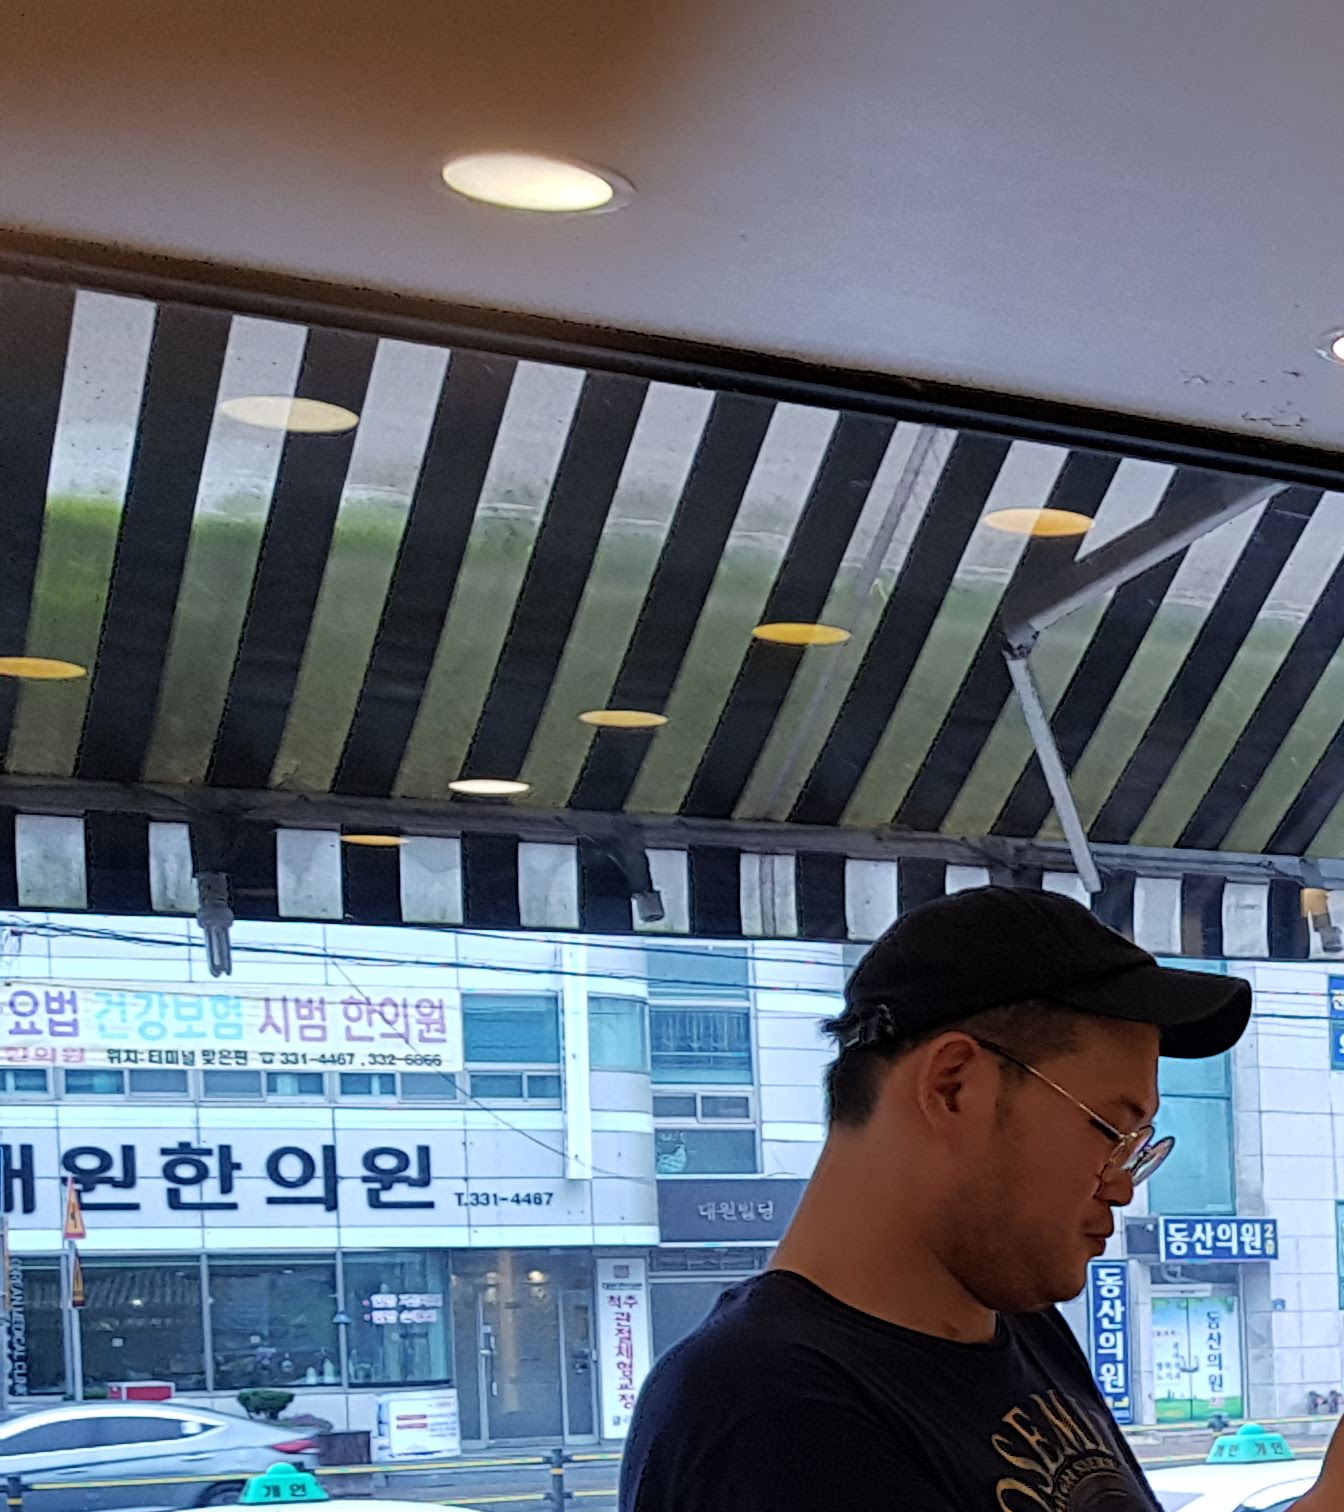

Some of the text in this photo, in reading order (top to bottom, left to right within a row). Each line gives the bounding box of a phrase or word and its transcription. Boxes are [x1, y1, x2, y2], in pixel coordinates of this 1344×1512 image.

[9, 989, 448, 1044] 요법 건강보험 시범 한의원
[1167, 1222, 1264, 1256] 동산의원
[1096, 1267, 1126, 1395] 동산의원
[262, 1482, 308, 1499] 개인
